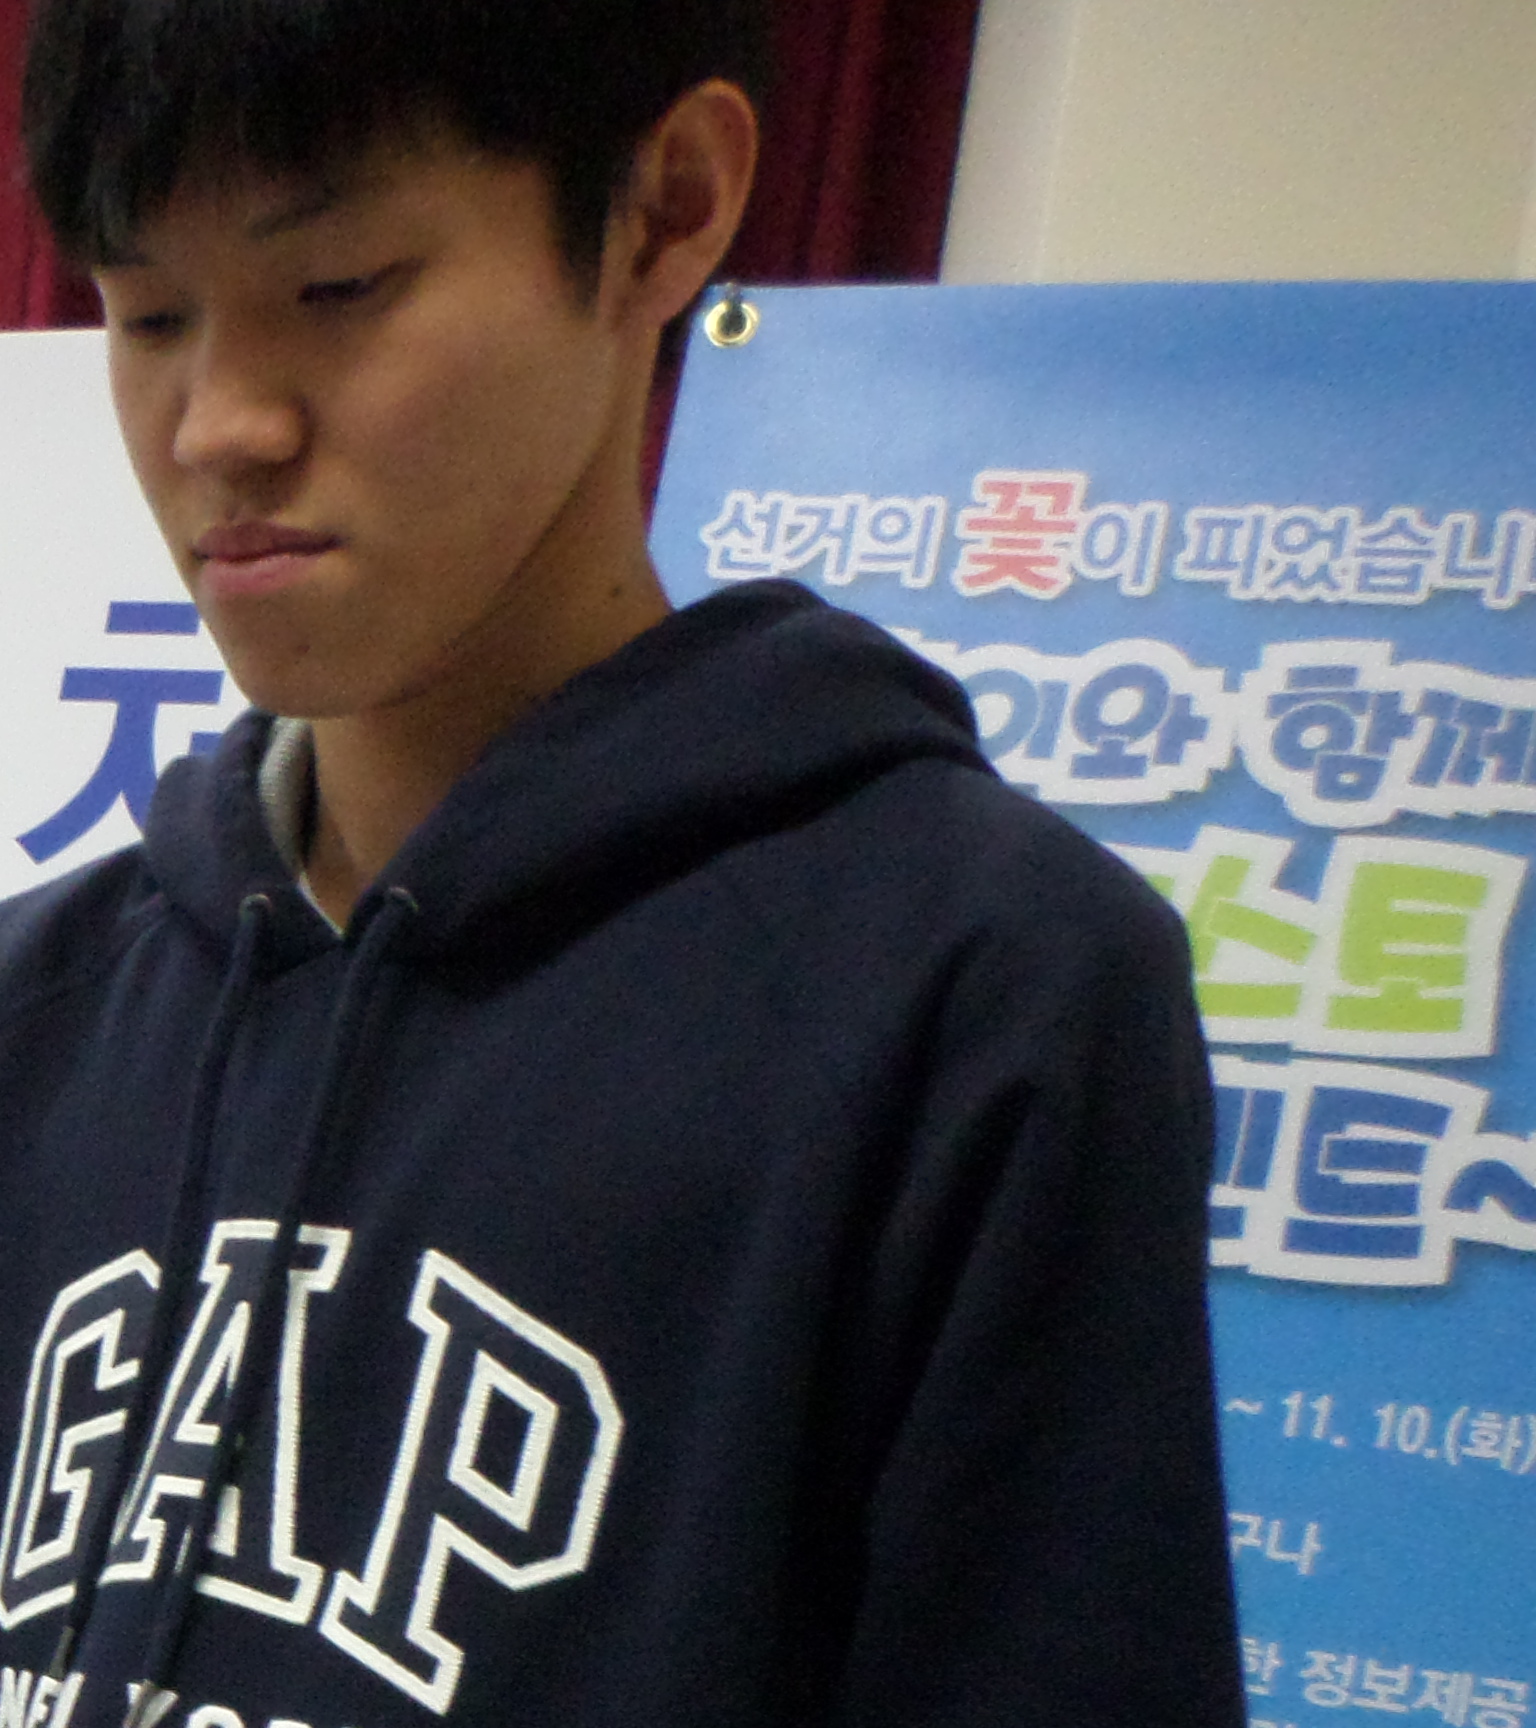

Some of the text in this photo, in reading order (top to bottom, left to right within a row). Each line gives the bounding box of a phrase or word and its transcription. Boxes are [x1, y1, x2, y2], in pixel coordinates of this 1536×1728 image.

[703, 470, 1536, 608] 선거의 꽃이 피었습니
[958, 650, 1536, 808] 이와 함께
[1146, 853, 1492, 1034] 스토
[1282, 1390, 1349, 1449] 11.
